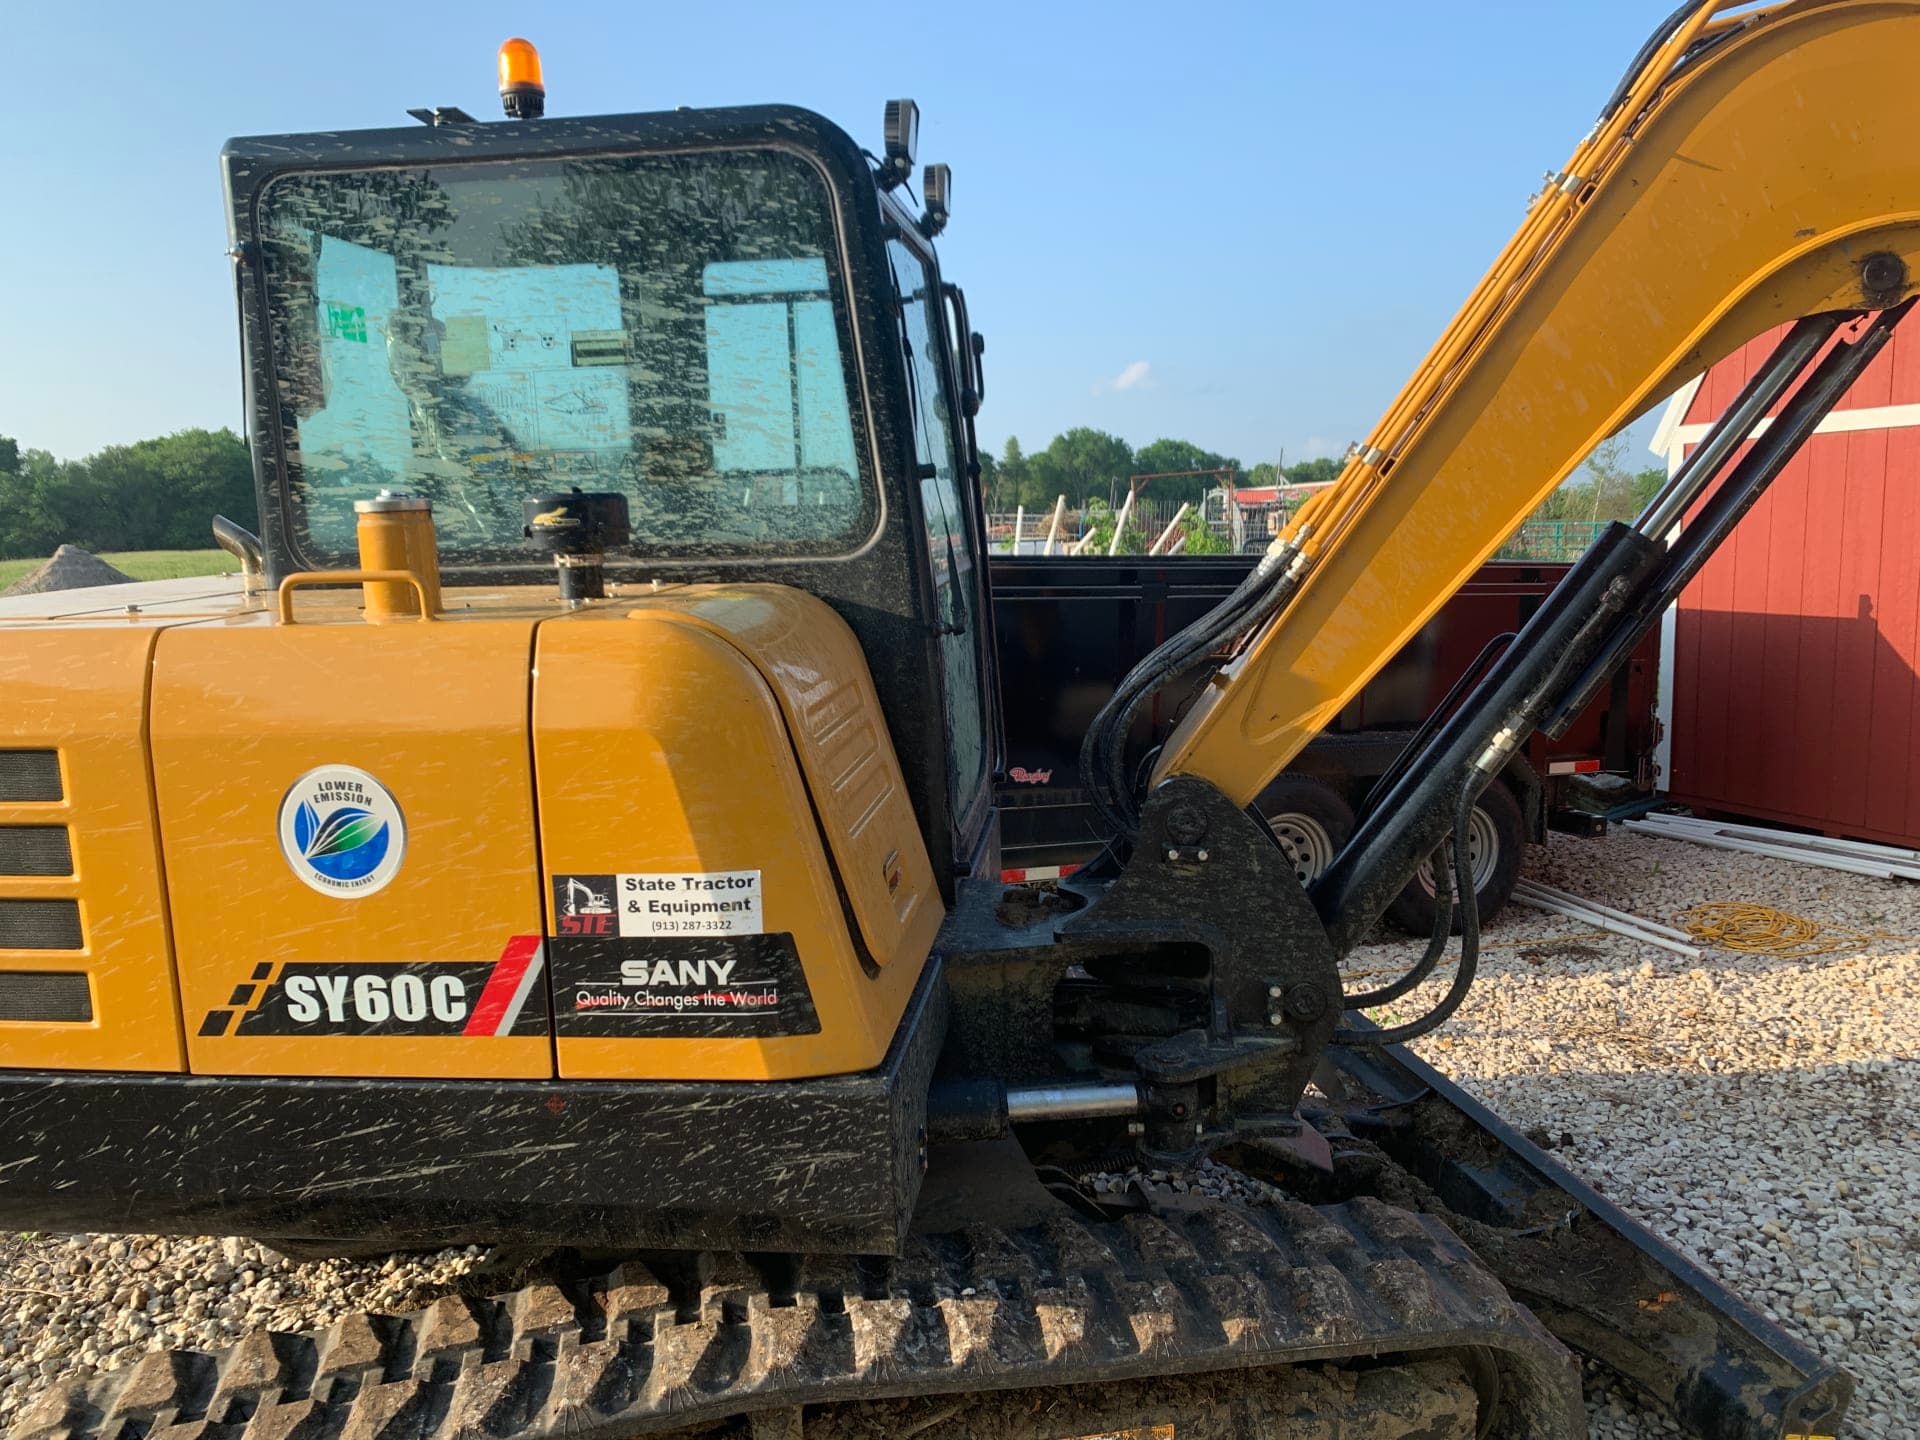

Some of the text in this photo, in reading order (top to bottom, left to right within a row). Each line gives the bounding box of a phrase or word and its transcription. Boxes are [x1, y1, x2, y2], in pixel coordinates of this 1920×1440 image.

[318, 781, 363, 793] LOWER
[313, 791, 372, 806] EMISSION
[625, 875, 754, 892] State Tractor
[627, 898, 751, 916] & Equipment
[560, 913, 617, 935] STE
[651, 920, 732, 932] (913) 287-3322
[619, 959, 737, 986] SANY
[284, 974, 466, 1023] SY60C
[576, 988, 777, 1009] Quality Changes the World
